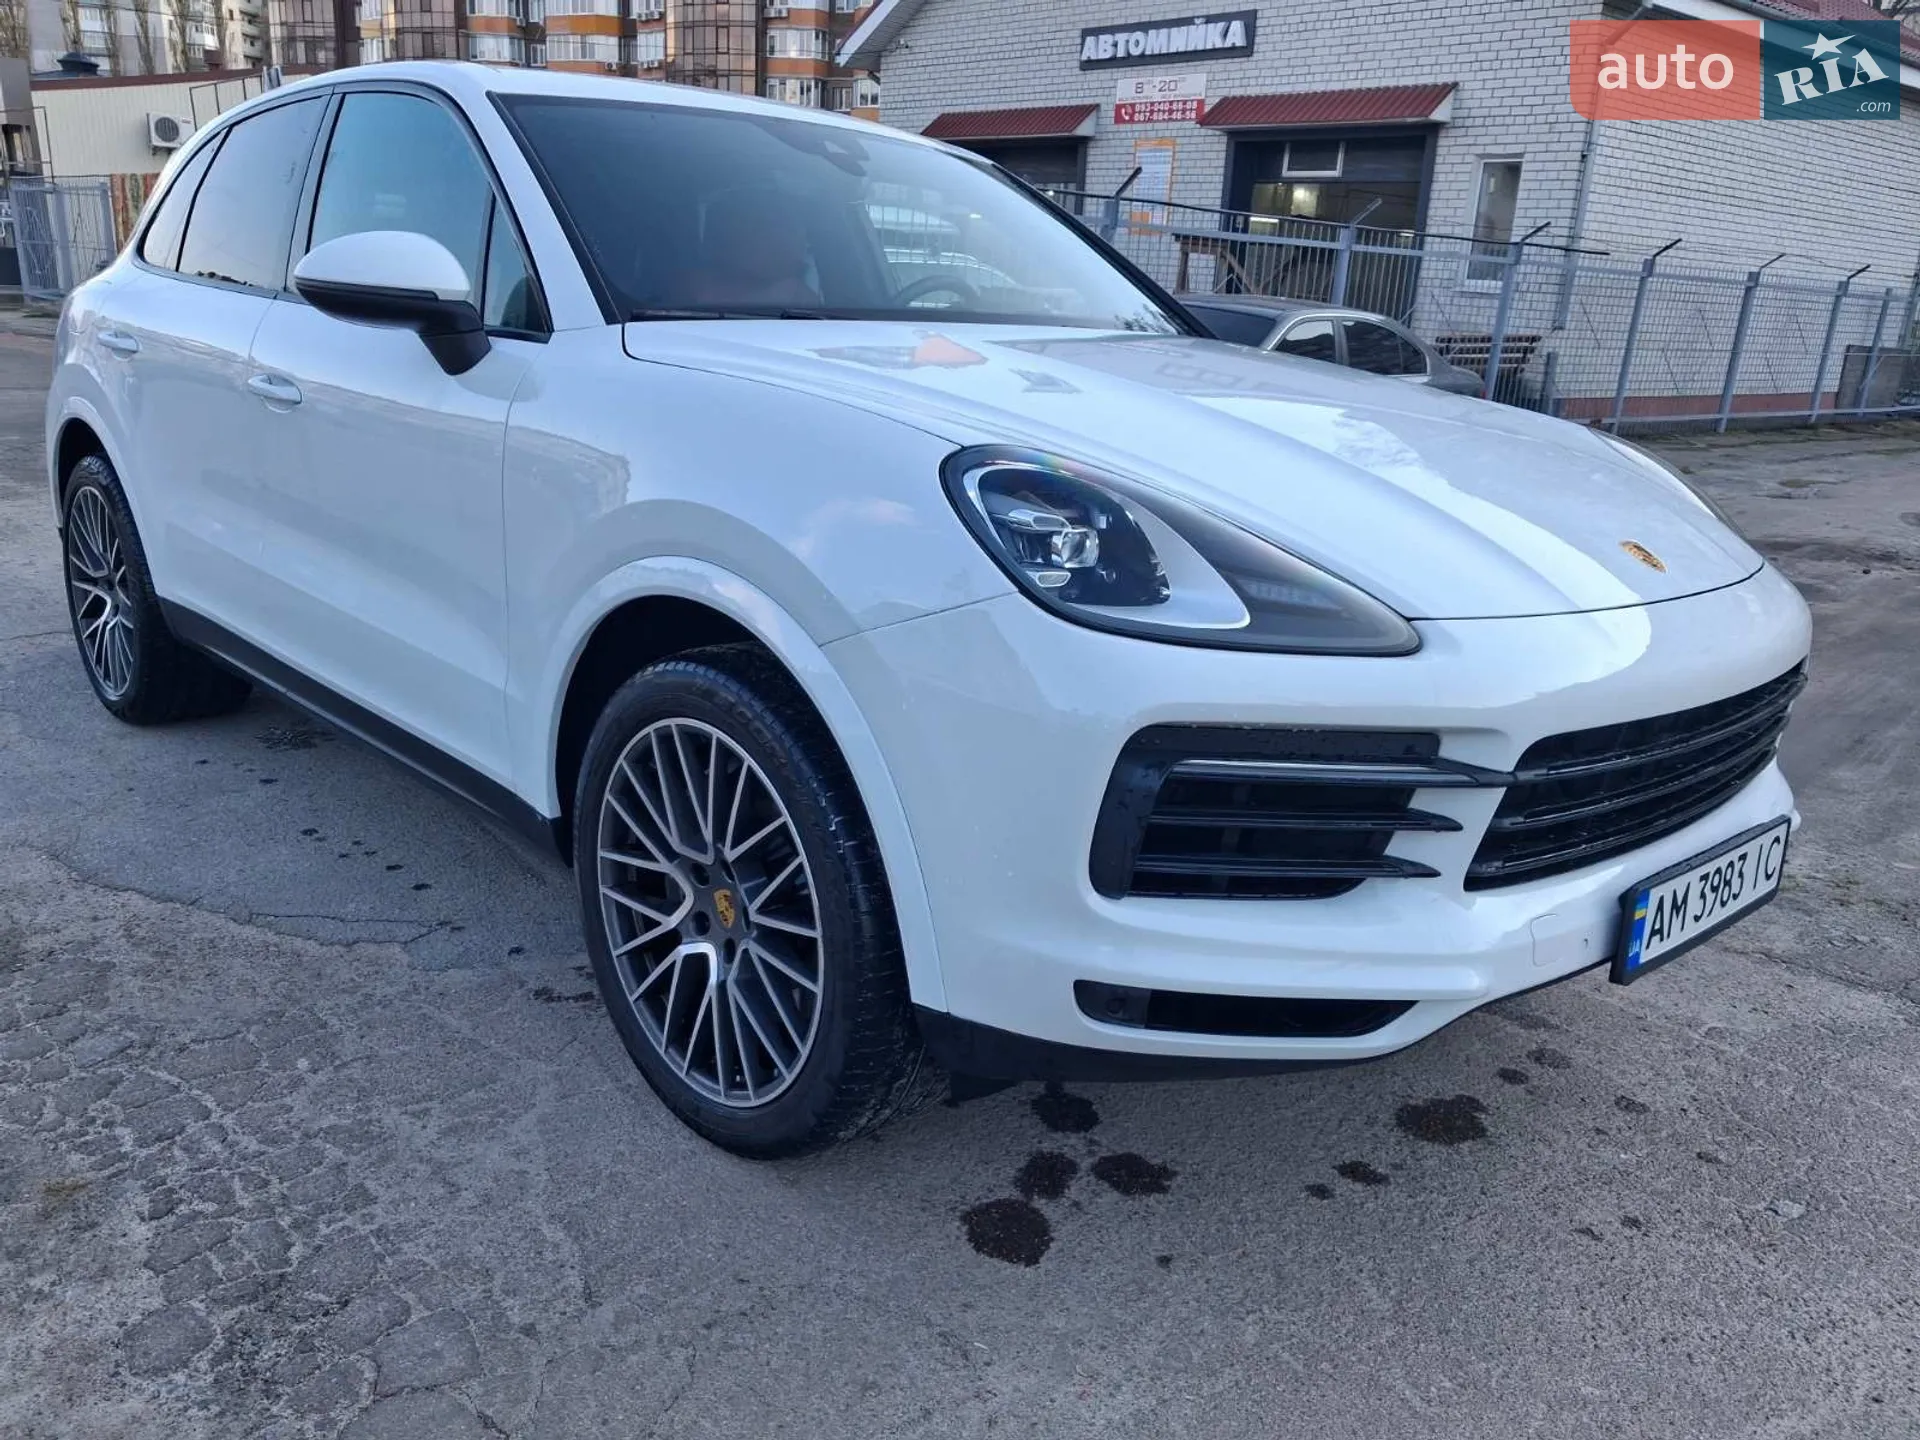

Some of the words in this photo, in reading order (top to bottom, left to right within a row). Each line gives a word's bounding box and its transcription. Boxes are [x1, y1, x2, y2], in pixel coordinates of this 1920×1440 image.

[1081, 18, 1247, 61] АВТОМИЙКА
[1646, 881, 1691, 950] AM
[1693, 851, 1749, 923] 3983
[1753, 835, 1781, 891] IC
